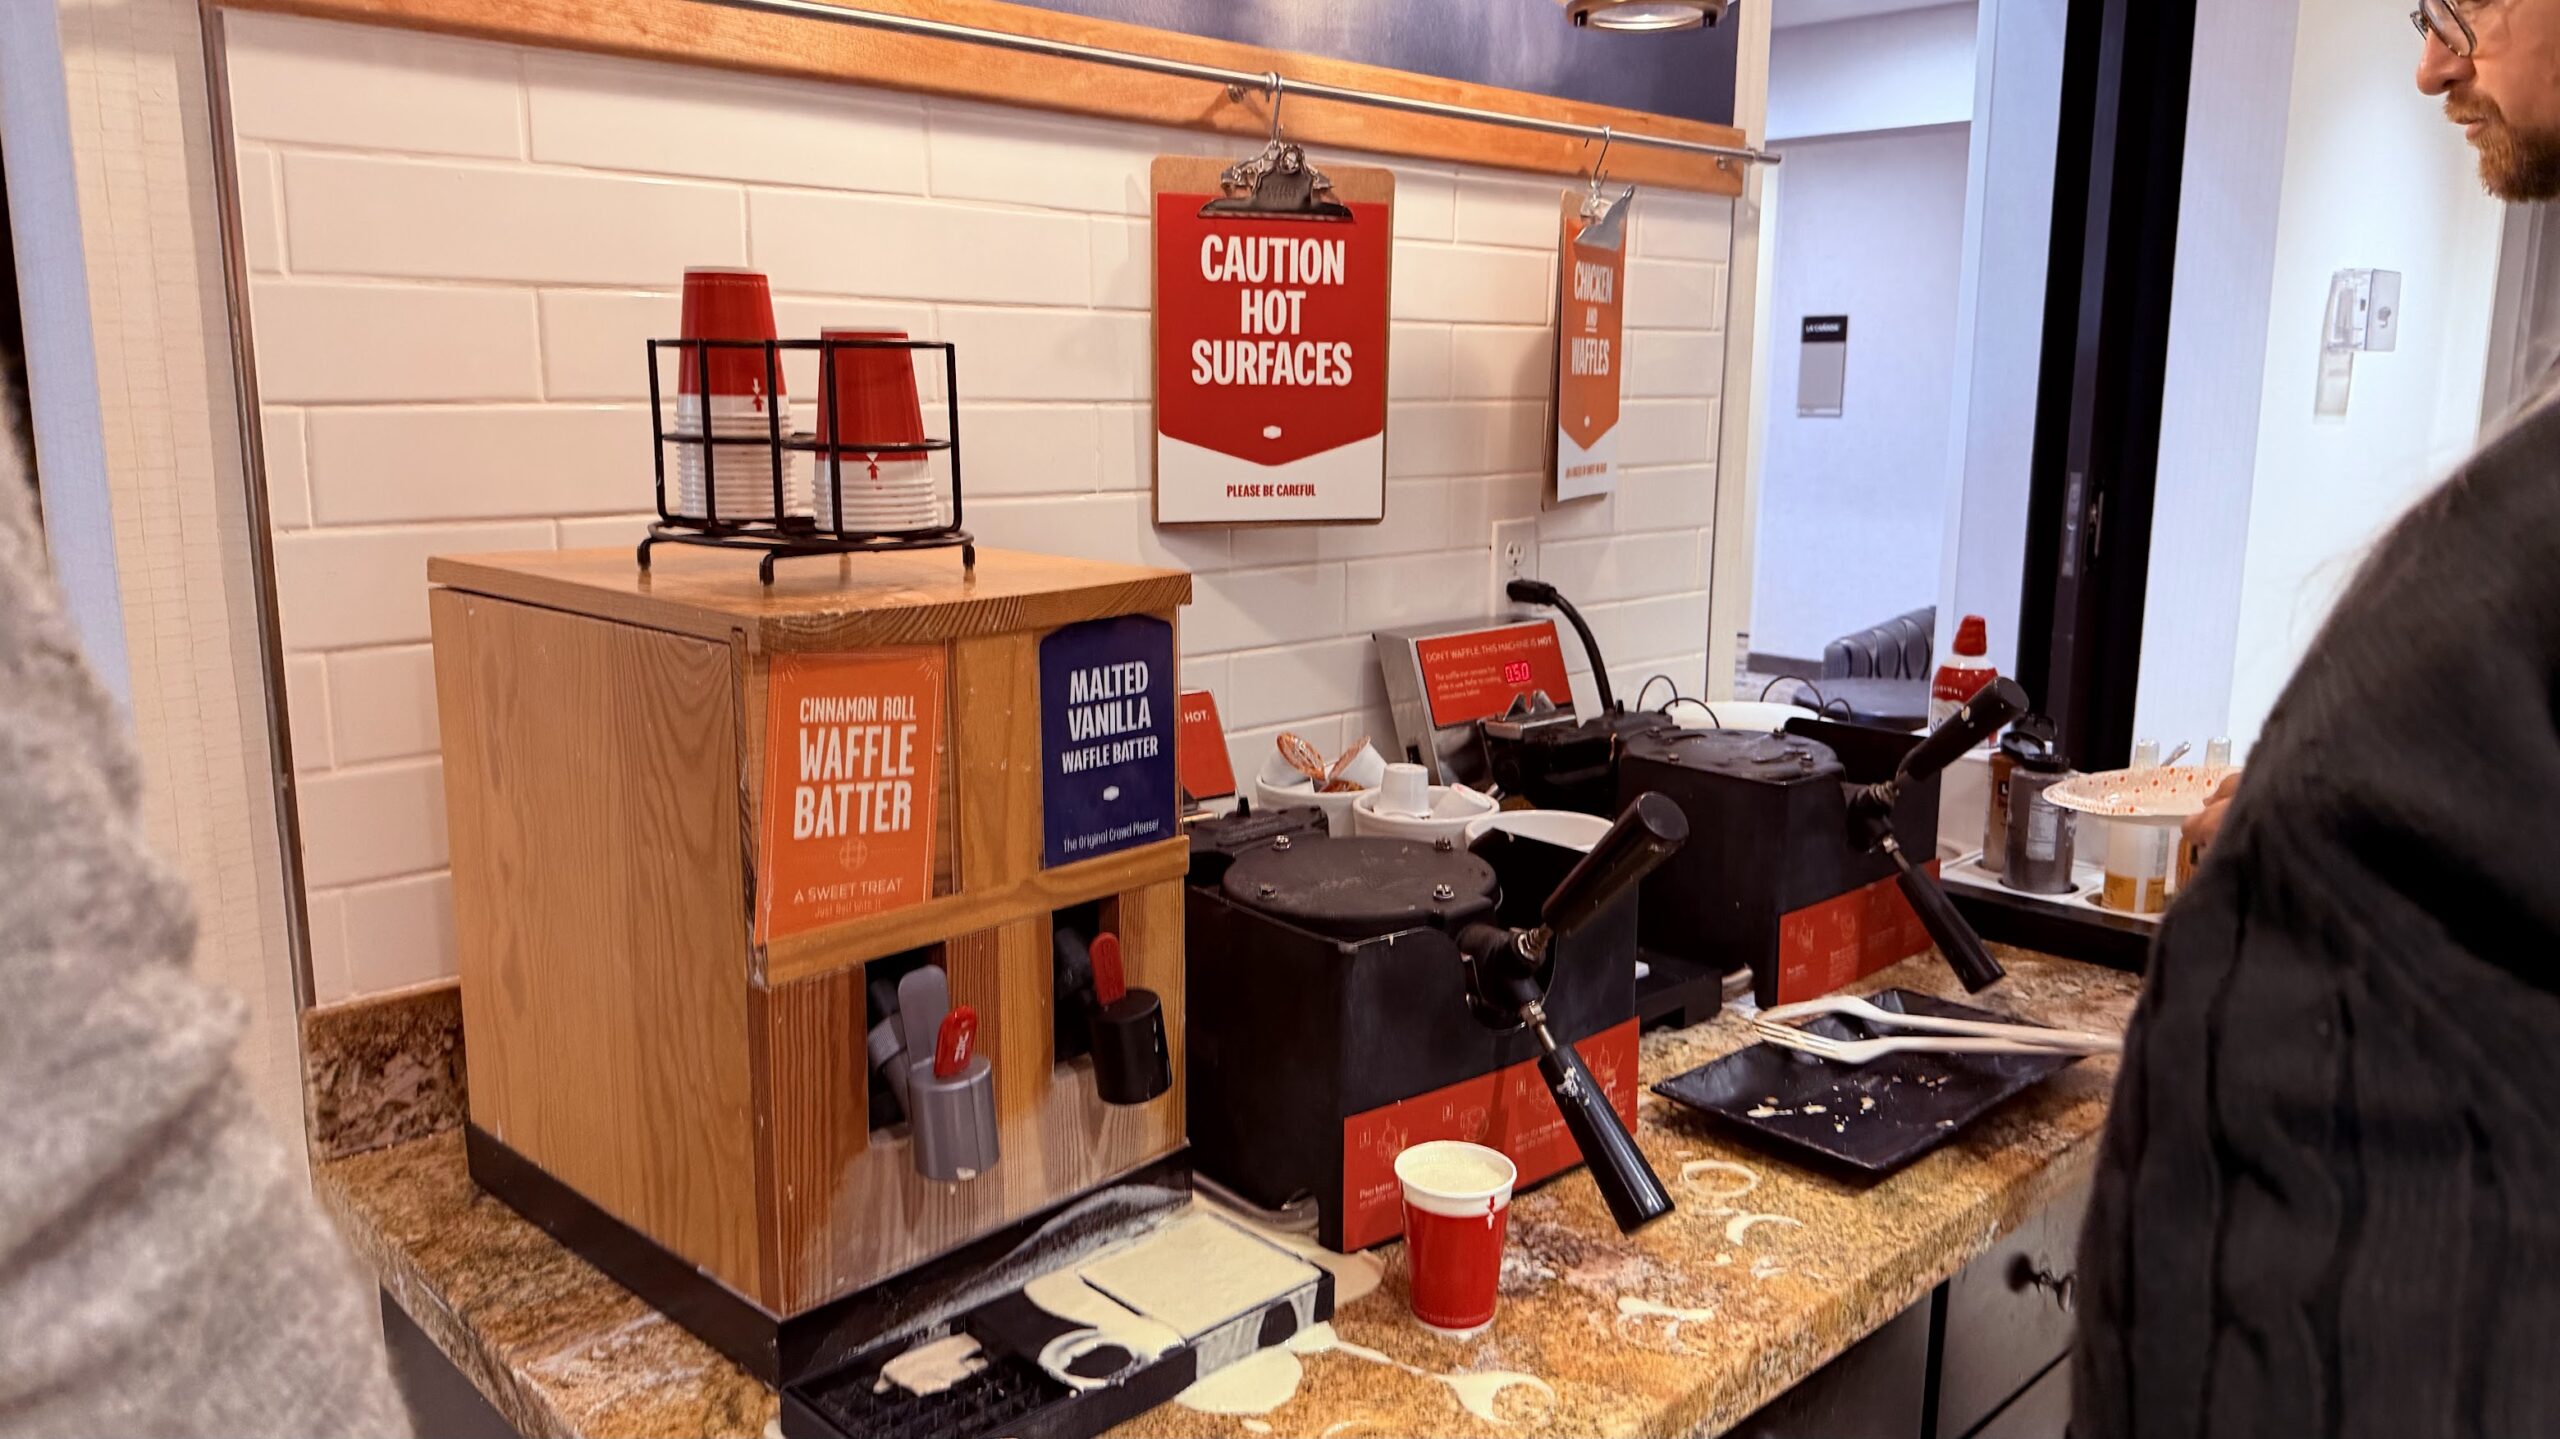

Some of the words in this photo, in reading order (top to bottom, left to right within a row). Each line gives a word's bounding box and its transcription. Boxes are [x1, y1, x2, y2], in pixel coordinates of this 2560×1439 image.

[1201, 234, 1345, 285] CAUTION
[1574, 260, 1613, 304] CHICKEN
[1241, 289, 1306, 335] HOT
[1191, 339, 1353, 386] SURFACES
[1571, 337, 1609, 375] WAFFLES
[1226, 484, 1260, 497] PLEASE
[1263, 484, 1274, 496] BE
[1276, 484, 1316, 496] CAREFUL
[1069, 660, 1148, 705] MALTED
[799, 697, 877, 723] CINNAMON
[882, 696, 916, 721] ROLL
[1067, 696, 1151, 742] VANILLA
[799, 724, 917, 782] WAFFLE
[1061, 746, 1110, 774] WAFFLE
[1112, 734, 1158, 764] BATTER
[793, 780, 912, 841] BATTER
[1063, 838, 1077, 854] The
[1078, 828, 1108, 850] Original
[1109, 822, 1132, 842] Crowd
[793, 889, 804, 904] A
[808, 882, 857, 903] SWEET
[861, 877, 903, 896] TREAT
